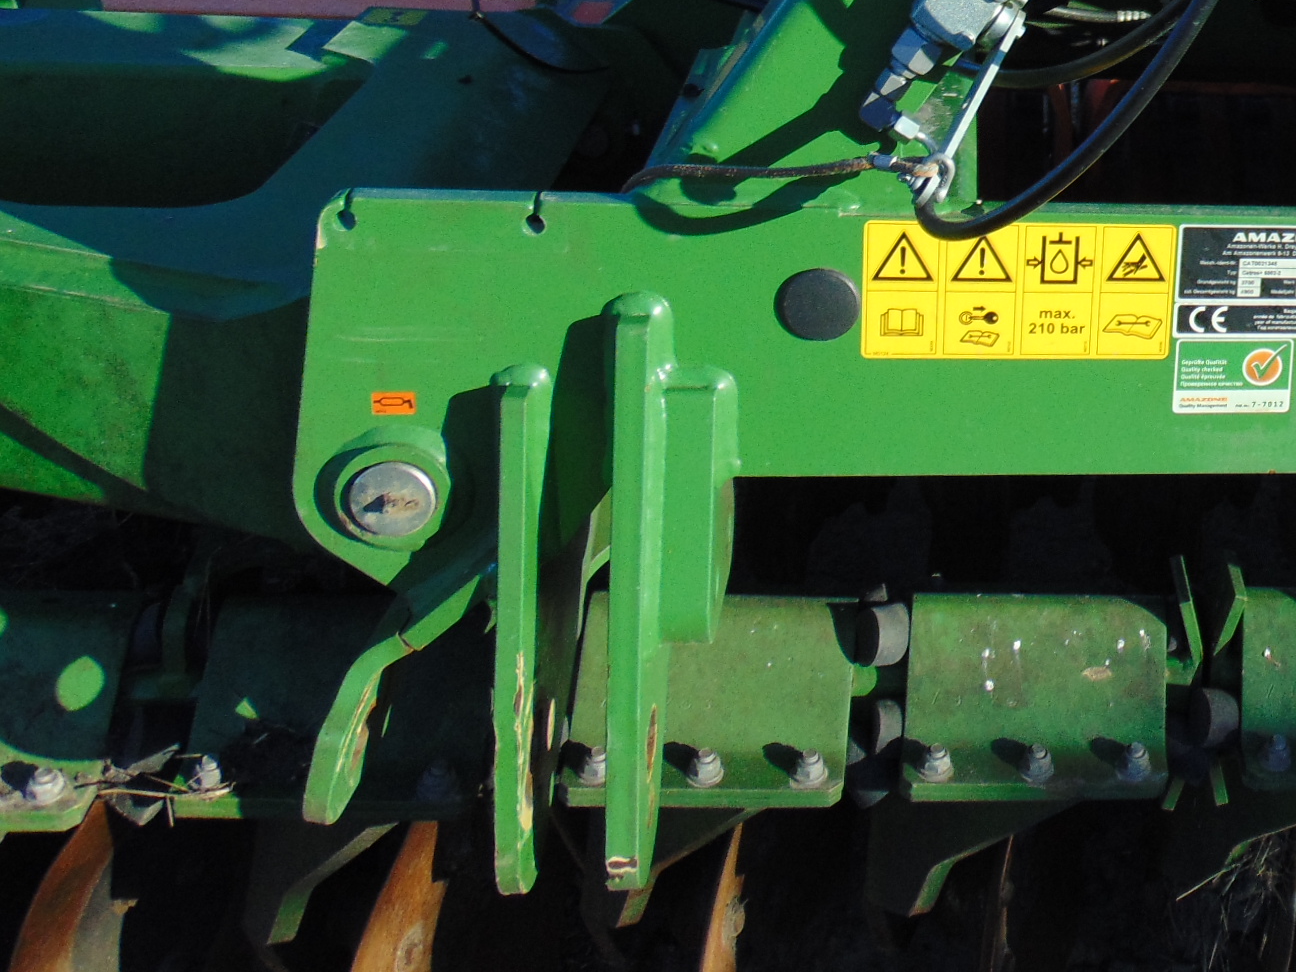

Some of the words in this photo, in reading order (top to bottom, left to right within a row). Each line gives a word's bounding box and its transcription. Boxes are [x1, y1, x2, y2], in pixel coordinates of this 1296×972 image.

[1039, 310, 1076, 319] max.
[1028, 322, 1055, 334] 210
[1060, 322, 1085, 334] bar
